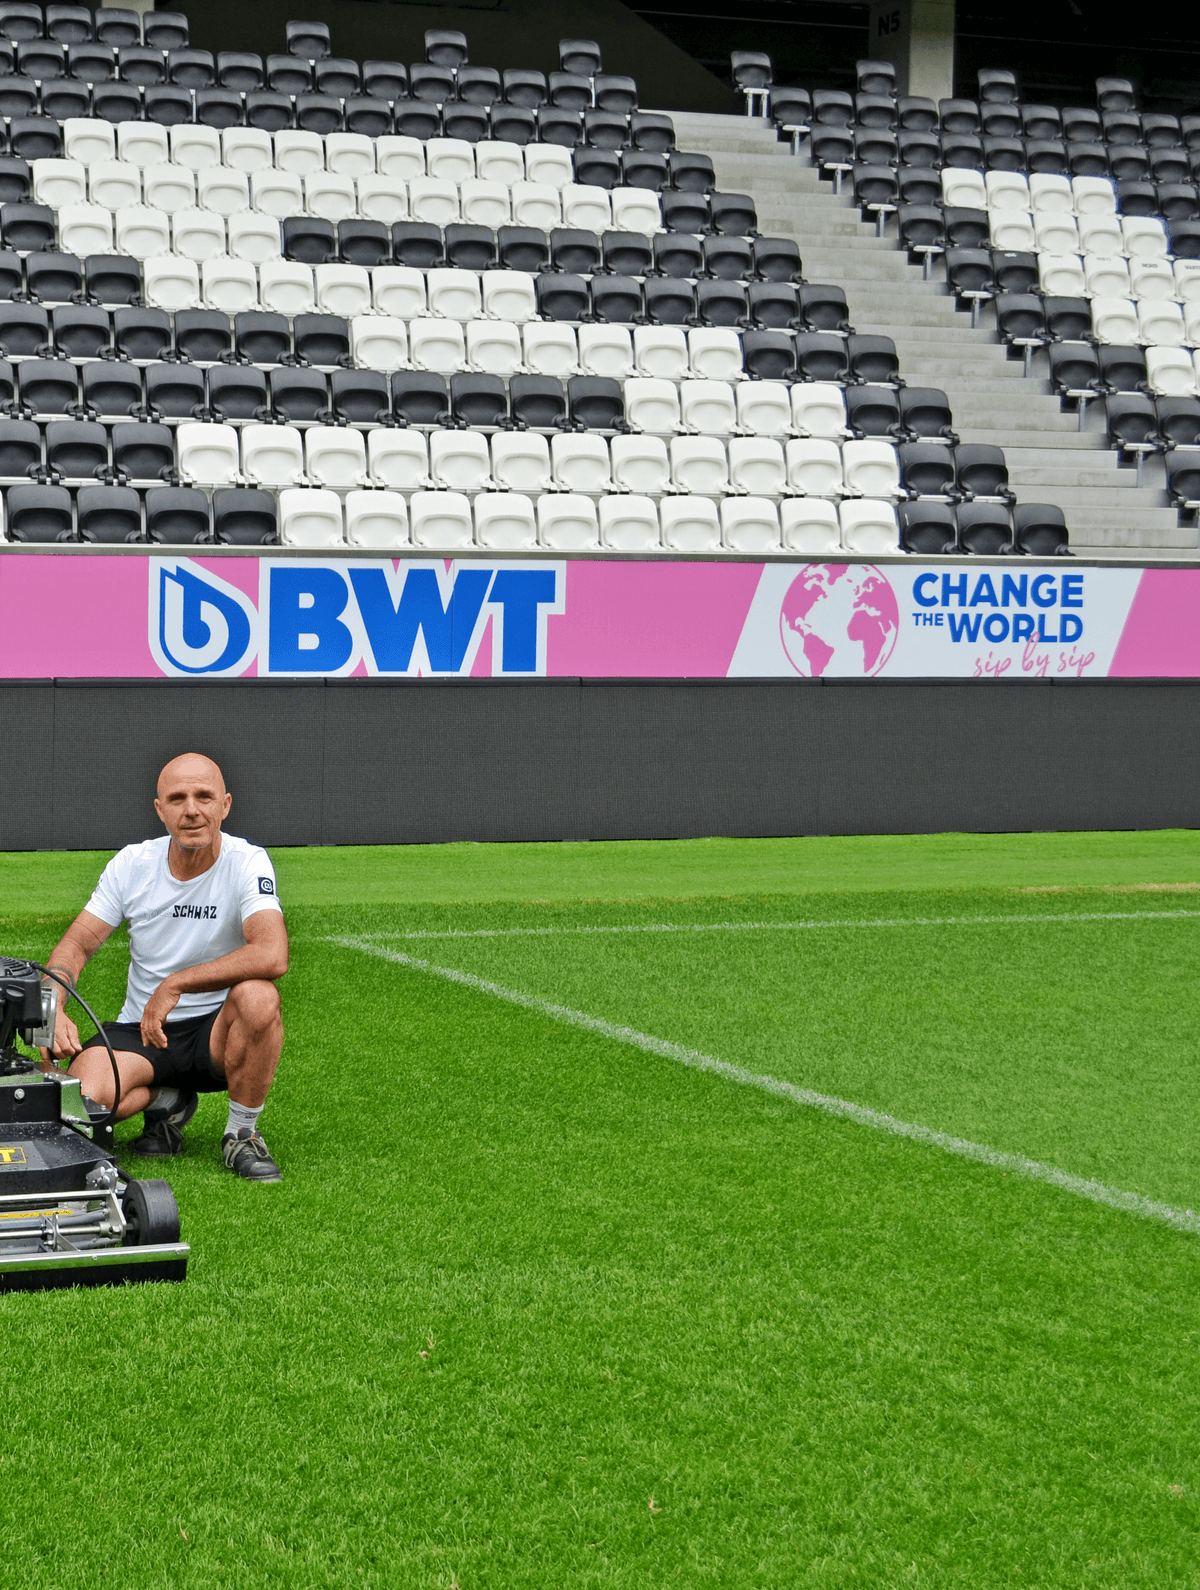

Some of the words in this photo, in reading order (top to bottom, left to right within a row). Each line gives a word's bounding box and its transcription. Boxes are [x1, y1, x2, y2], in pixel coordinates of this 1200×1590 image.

[912, 572, 1084, 608] CHANGE
[268, 567, 556, 672] BWT
[912, 613, 944, 626] THE
[947, 612, 1084, 643] WORLD
[973, 651, 1012, 678] sip
[1021, 631, 1051, 678] by
[1057, 645, 1095, 678] sip
